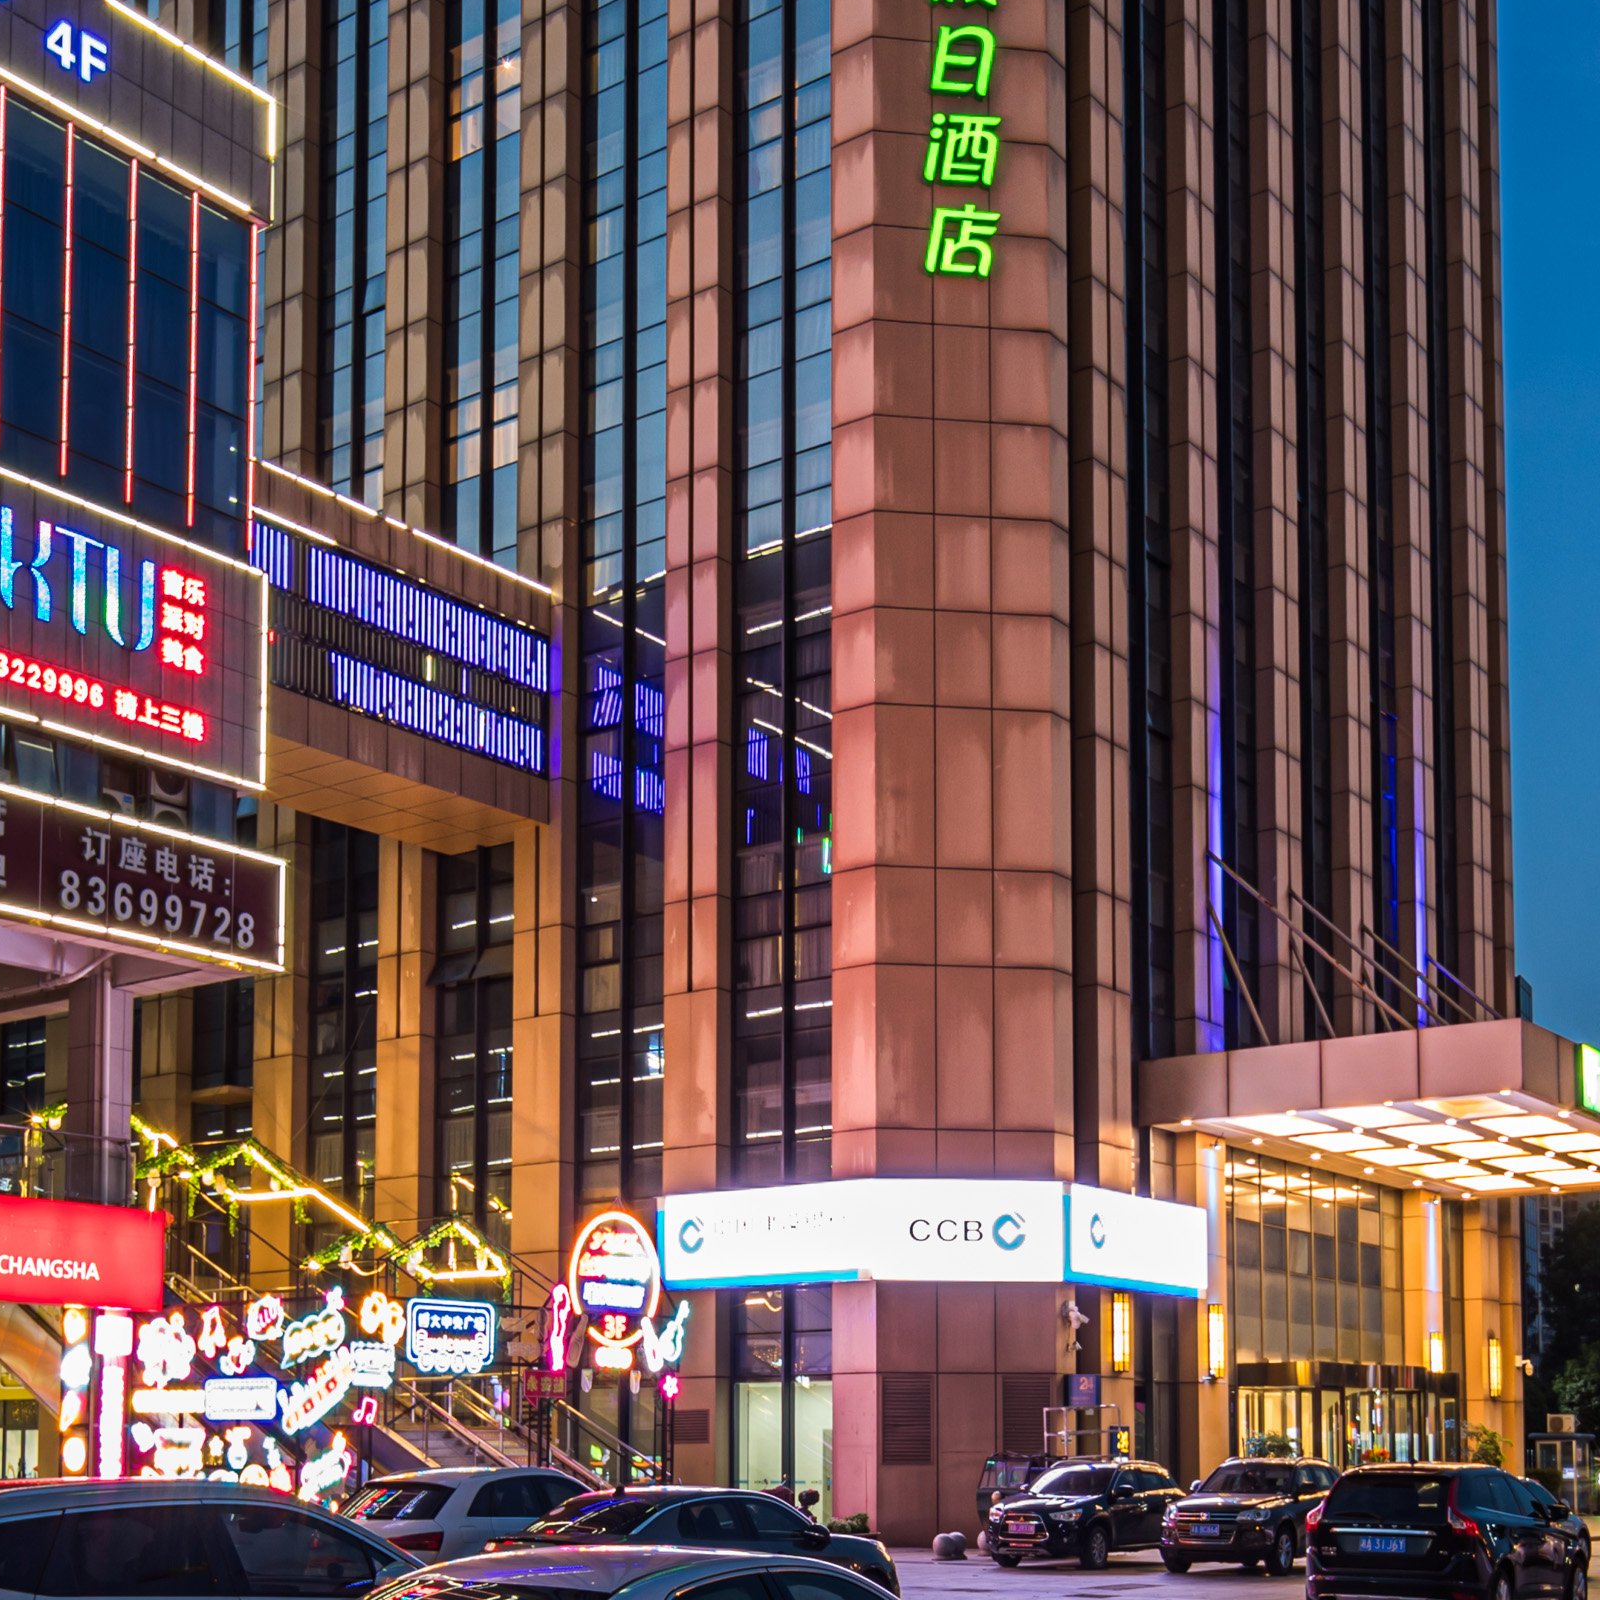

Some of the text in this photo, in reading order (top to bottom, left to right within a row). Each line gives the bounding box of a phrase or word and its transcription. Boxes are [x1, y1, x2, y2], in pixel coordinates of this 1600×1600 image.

[45, 19, 109, 83] 4F
[161, 567, 207, 607] 音乐
[161, 601, 207, 642] 派对
[161, 636, 207, 675] 美食
[113, 687, 206, 743] 请上三楼
[59, 869, 257, 951] 83699728
[908, 1218, 984, 1243] CCB
